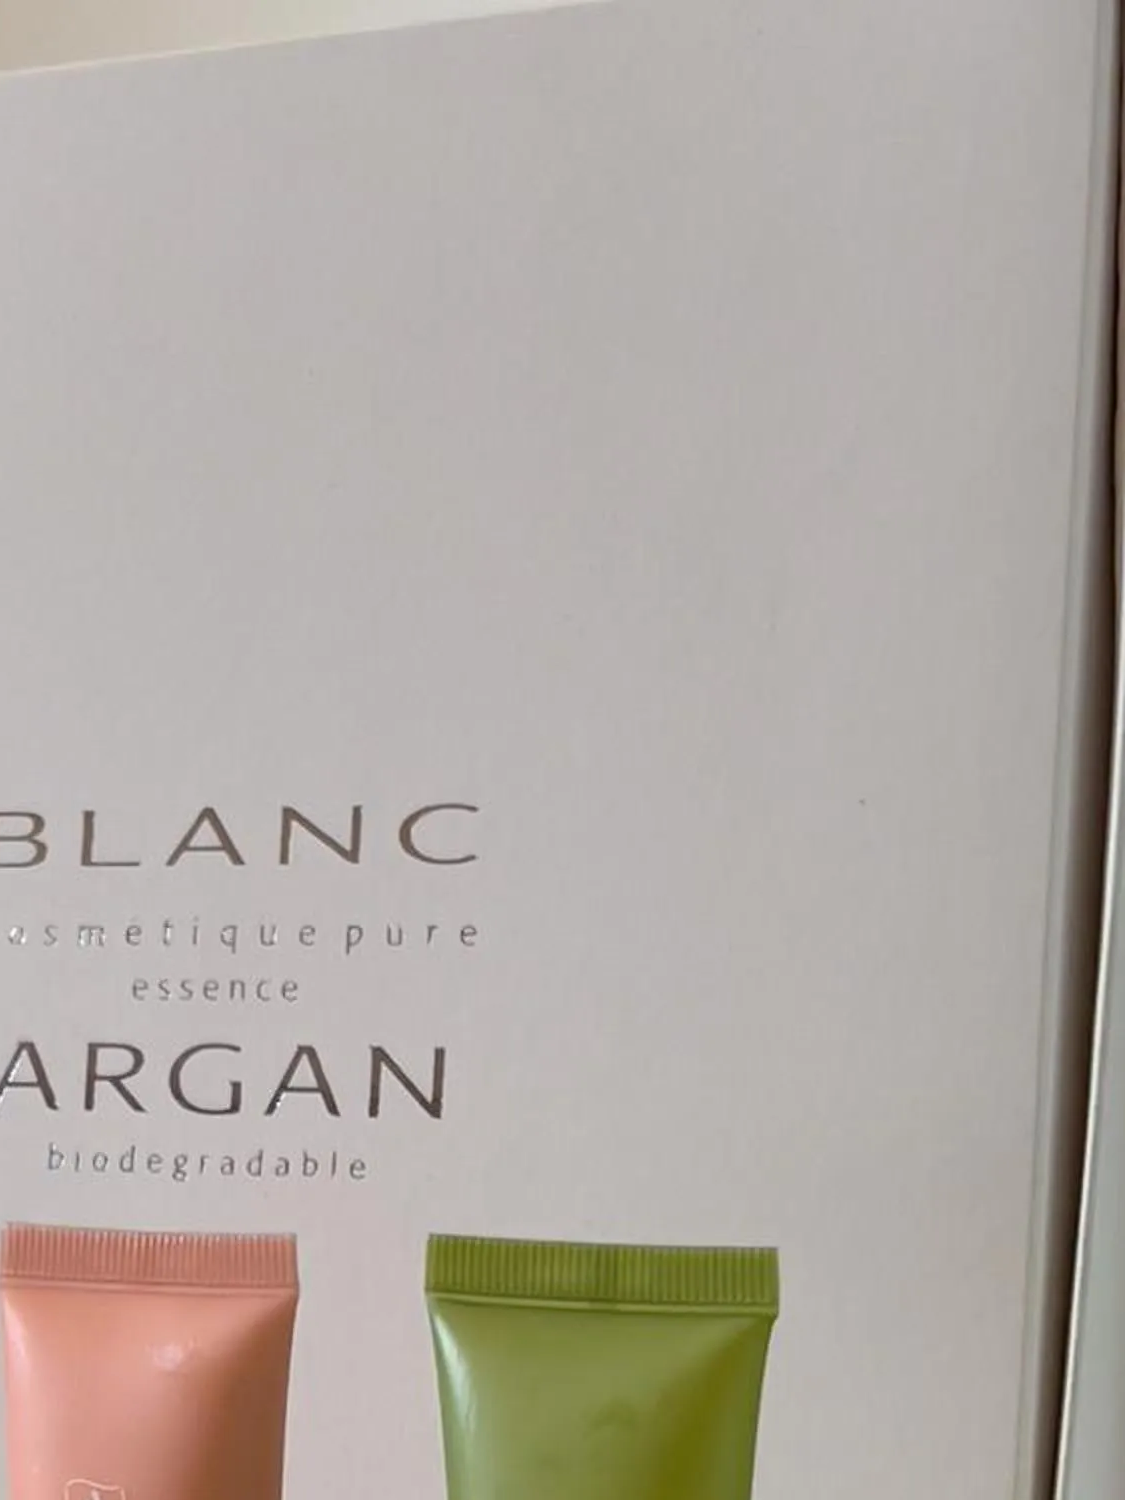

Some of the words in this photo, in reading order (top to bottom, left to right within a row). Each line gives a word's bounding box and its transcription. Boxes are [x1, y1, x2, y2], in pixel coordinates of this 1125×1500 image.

[345, 921, 479, 955] pure
[131, 975, 300, 1002] essence
[47, 1141, 368, 1182] biodegradable
